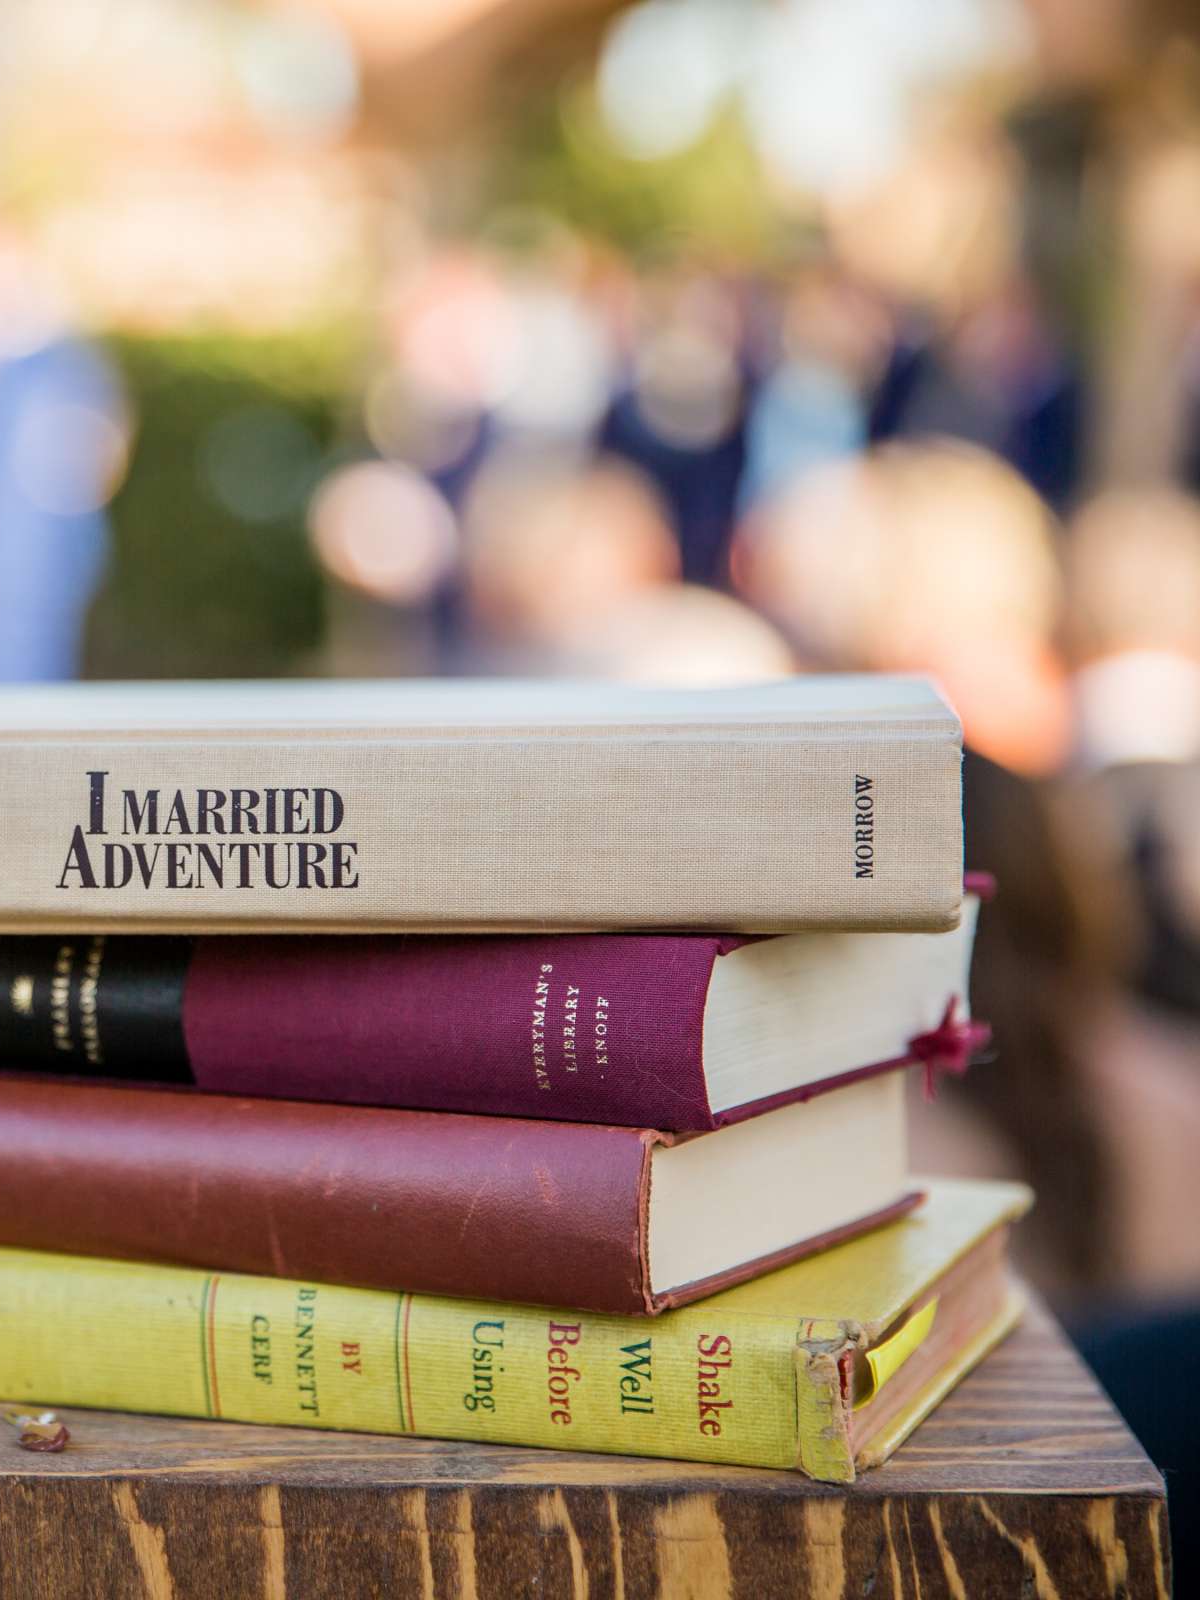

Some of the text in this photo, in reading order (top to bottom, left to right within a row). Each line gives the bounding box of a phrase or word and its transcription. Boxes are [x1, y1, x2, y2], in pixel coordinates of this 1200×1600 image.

[85, 771, 345, 836] I MARRIED
[855, 774, 875, 879] MORROW
[55, 824, 360, 890] ADVENTURE
[532, 963, 553, 1090] EVERYMAN'S
[562, 985, 580, 1074] LIBRARY
[595, 996, 609, 1065] KNOPF
[251, 1314, 273, 1386] CERF
[295, 1288, 320, 1418] BENNETT
[341, 1340, 363, 1377] BY
[463, 1319, 505, 1414] Using
[547, 1319, 582, 1427] Before
[618, 1337, 655, 1416] Well
[696, 1333, 734, 1437] Shake
